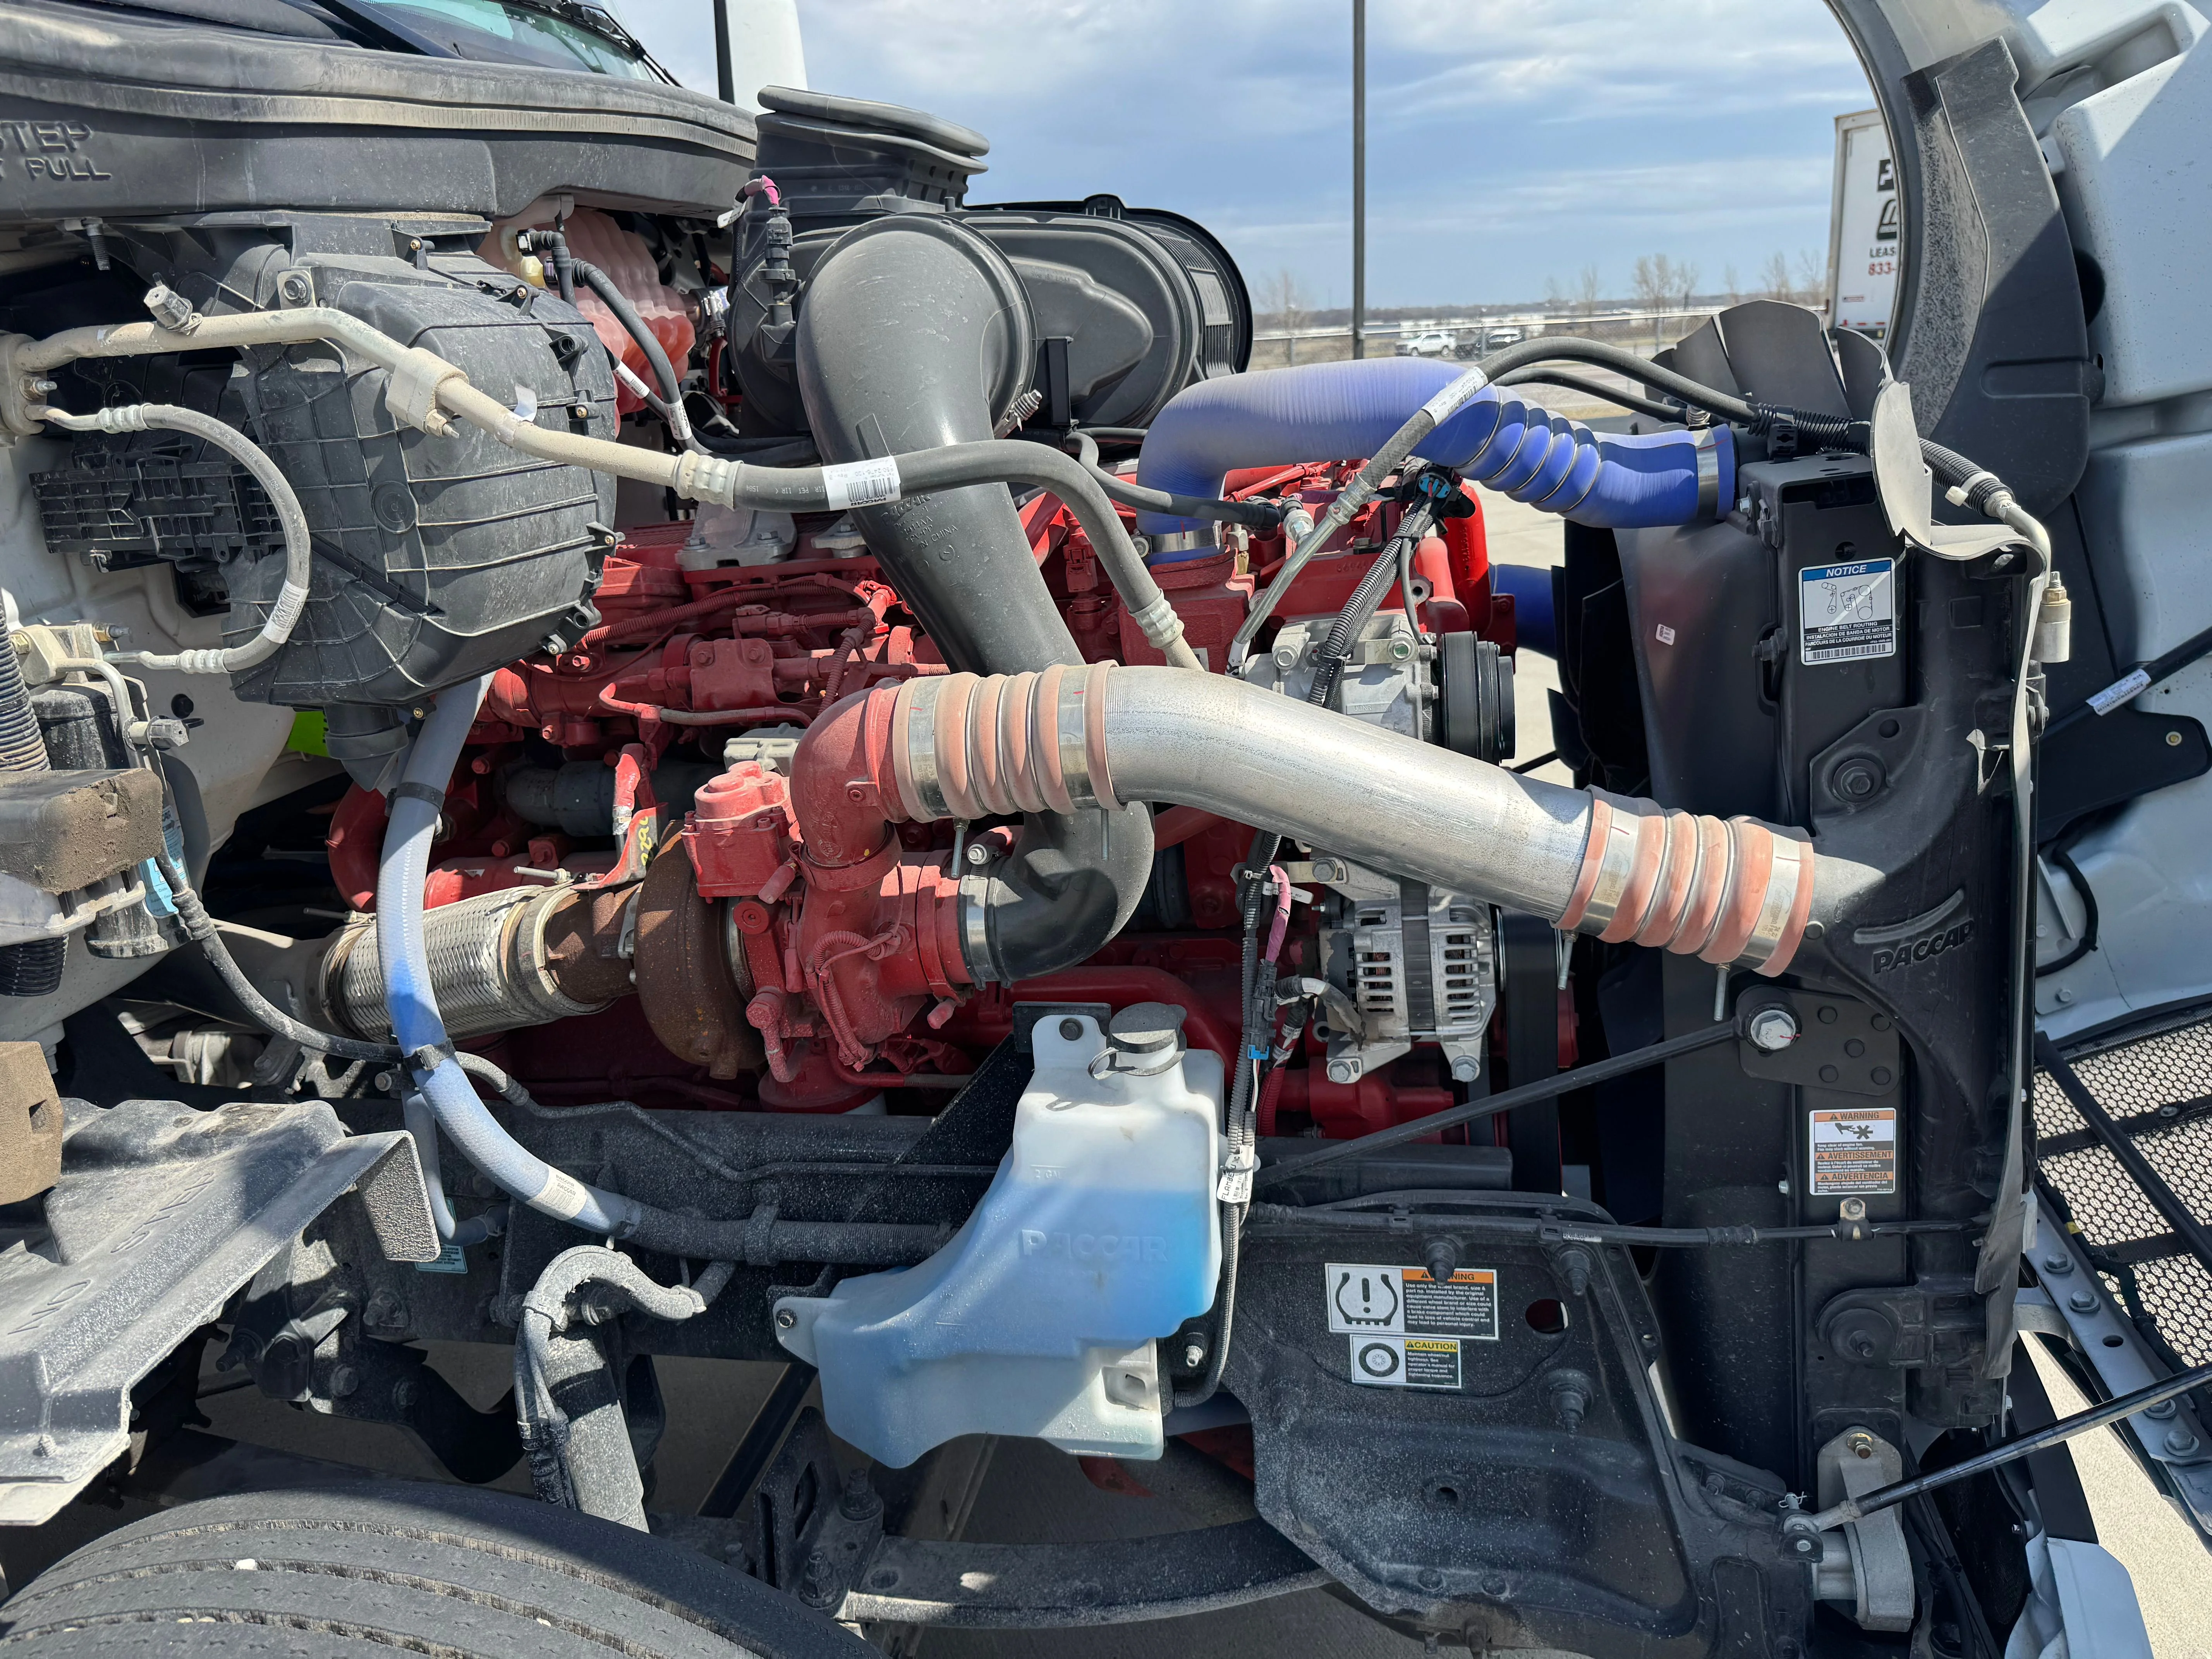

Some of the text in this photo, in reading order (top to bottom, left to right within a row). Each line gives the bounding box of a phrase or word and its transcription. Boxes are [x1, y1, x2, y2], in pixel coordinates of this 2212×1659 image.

[0, 120, 93, 153] TEP
[25, 156, 113, 182] PULL
[234, 441, 245, 450] PET
[851, 497, 886, 506] PACCAR
[920, 525, 959, 550] IN CHINA
[1826, 565, 1867, 577] NOTICE
[1873, 918, 1974, 974] PACCAR
[1840, 1112, 1879, 1120] WARNING
[1045, 1170, 1062, 1180] GAL
[1221, 1164, 1237, 1200] FLAMBEU
[557, 1183, 576, 1196] PACCAR
[110, 1172, 215, 1254] STEP
[1018, 1229, 1168, 1262] PACCAR
[7, 1279, 93, 1335] NO
[1414, 1341, 1456, 1350] CAUTION
